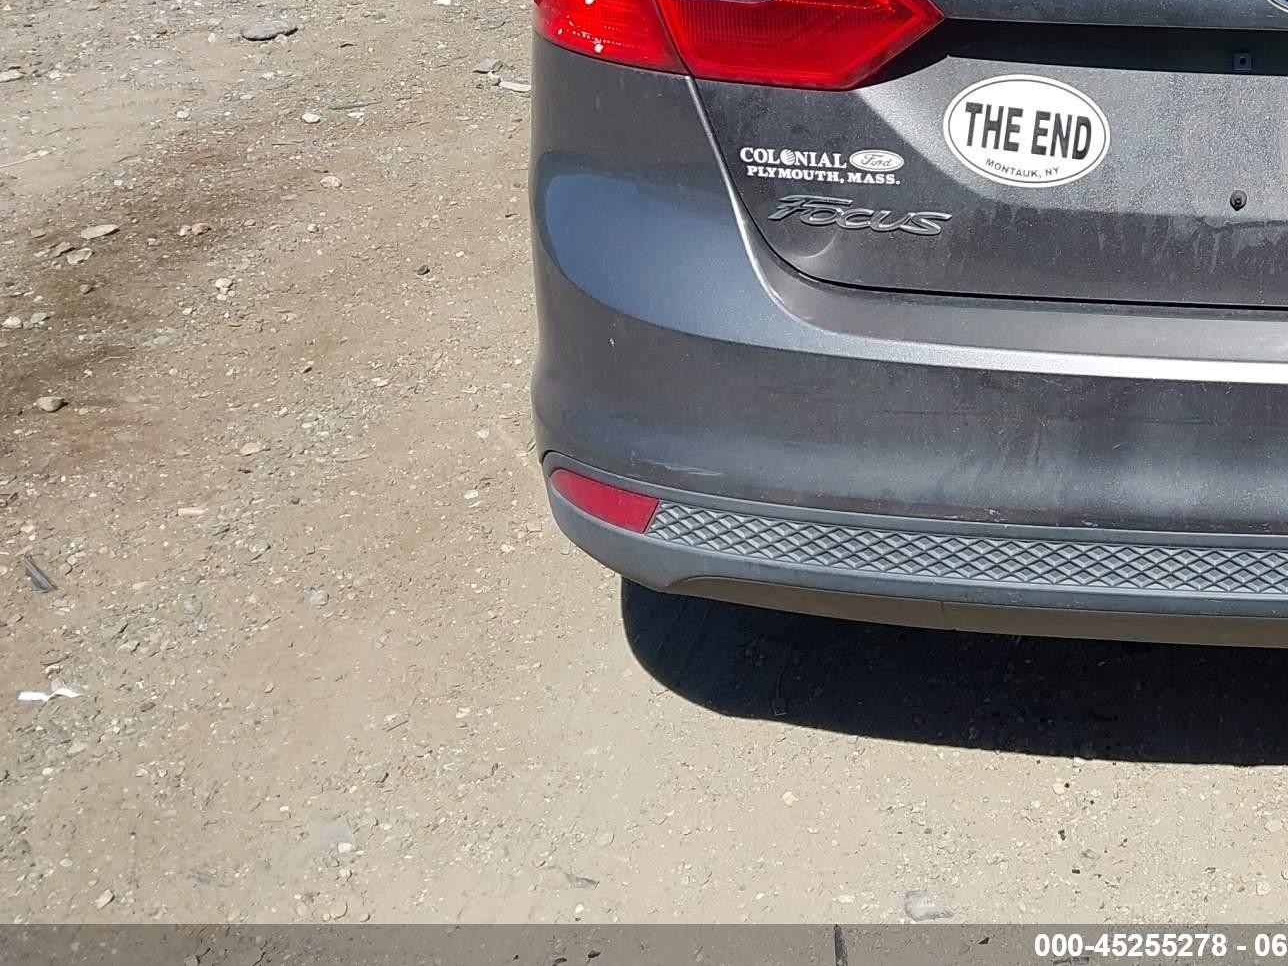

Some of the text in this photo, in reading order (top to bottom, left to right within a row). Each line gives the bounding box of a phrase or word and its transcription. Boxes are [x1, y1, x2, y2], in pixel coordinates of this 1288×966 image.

[965, 101, 1092, 161] THE END
[739, 147, 847, 169] COLONIAL
[859, 152, 892, 167] Ford
[984, 157, 1061, 179] MONTAUK, NY
[746, 164, 901, 185] PLYMOUTH, MASS.
